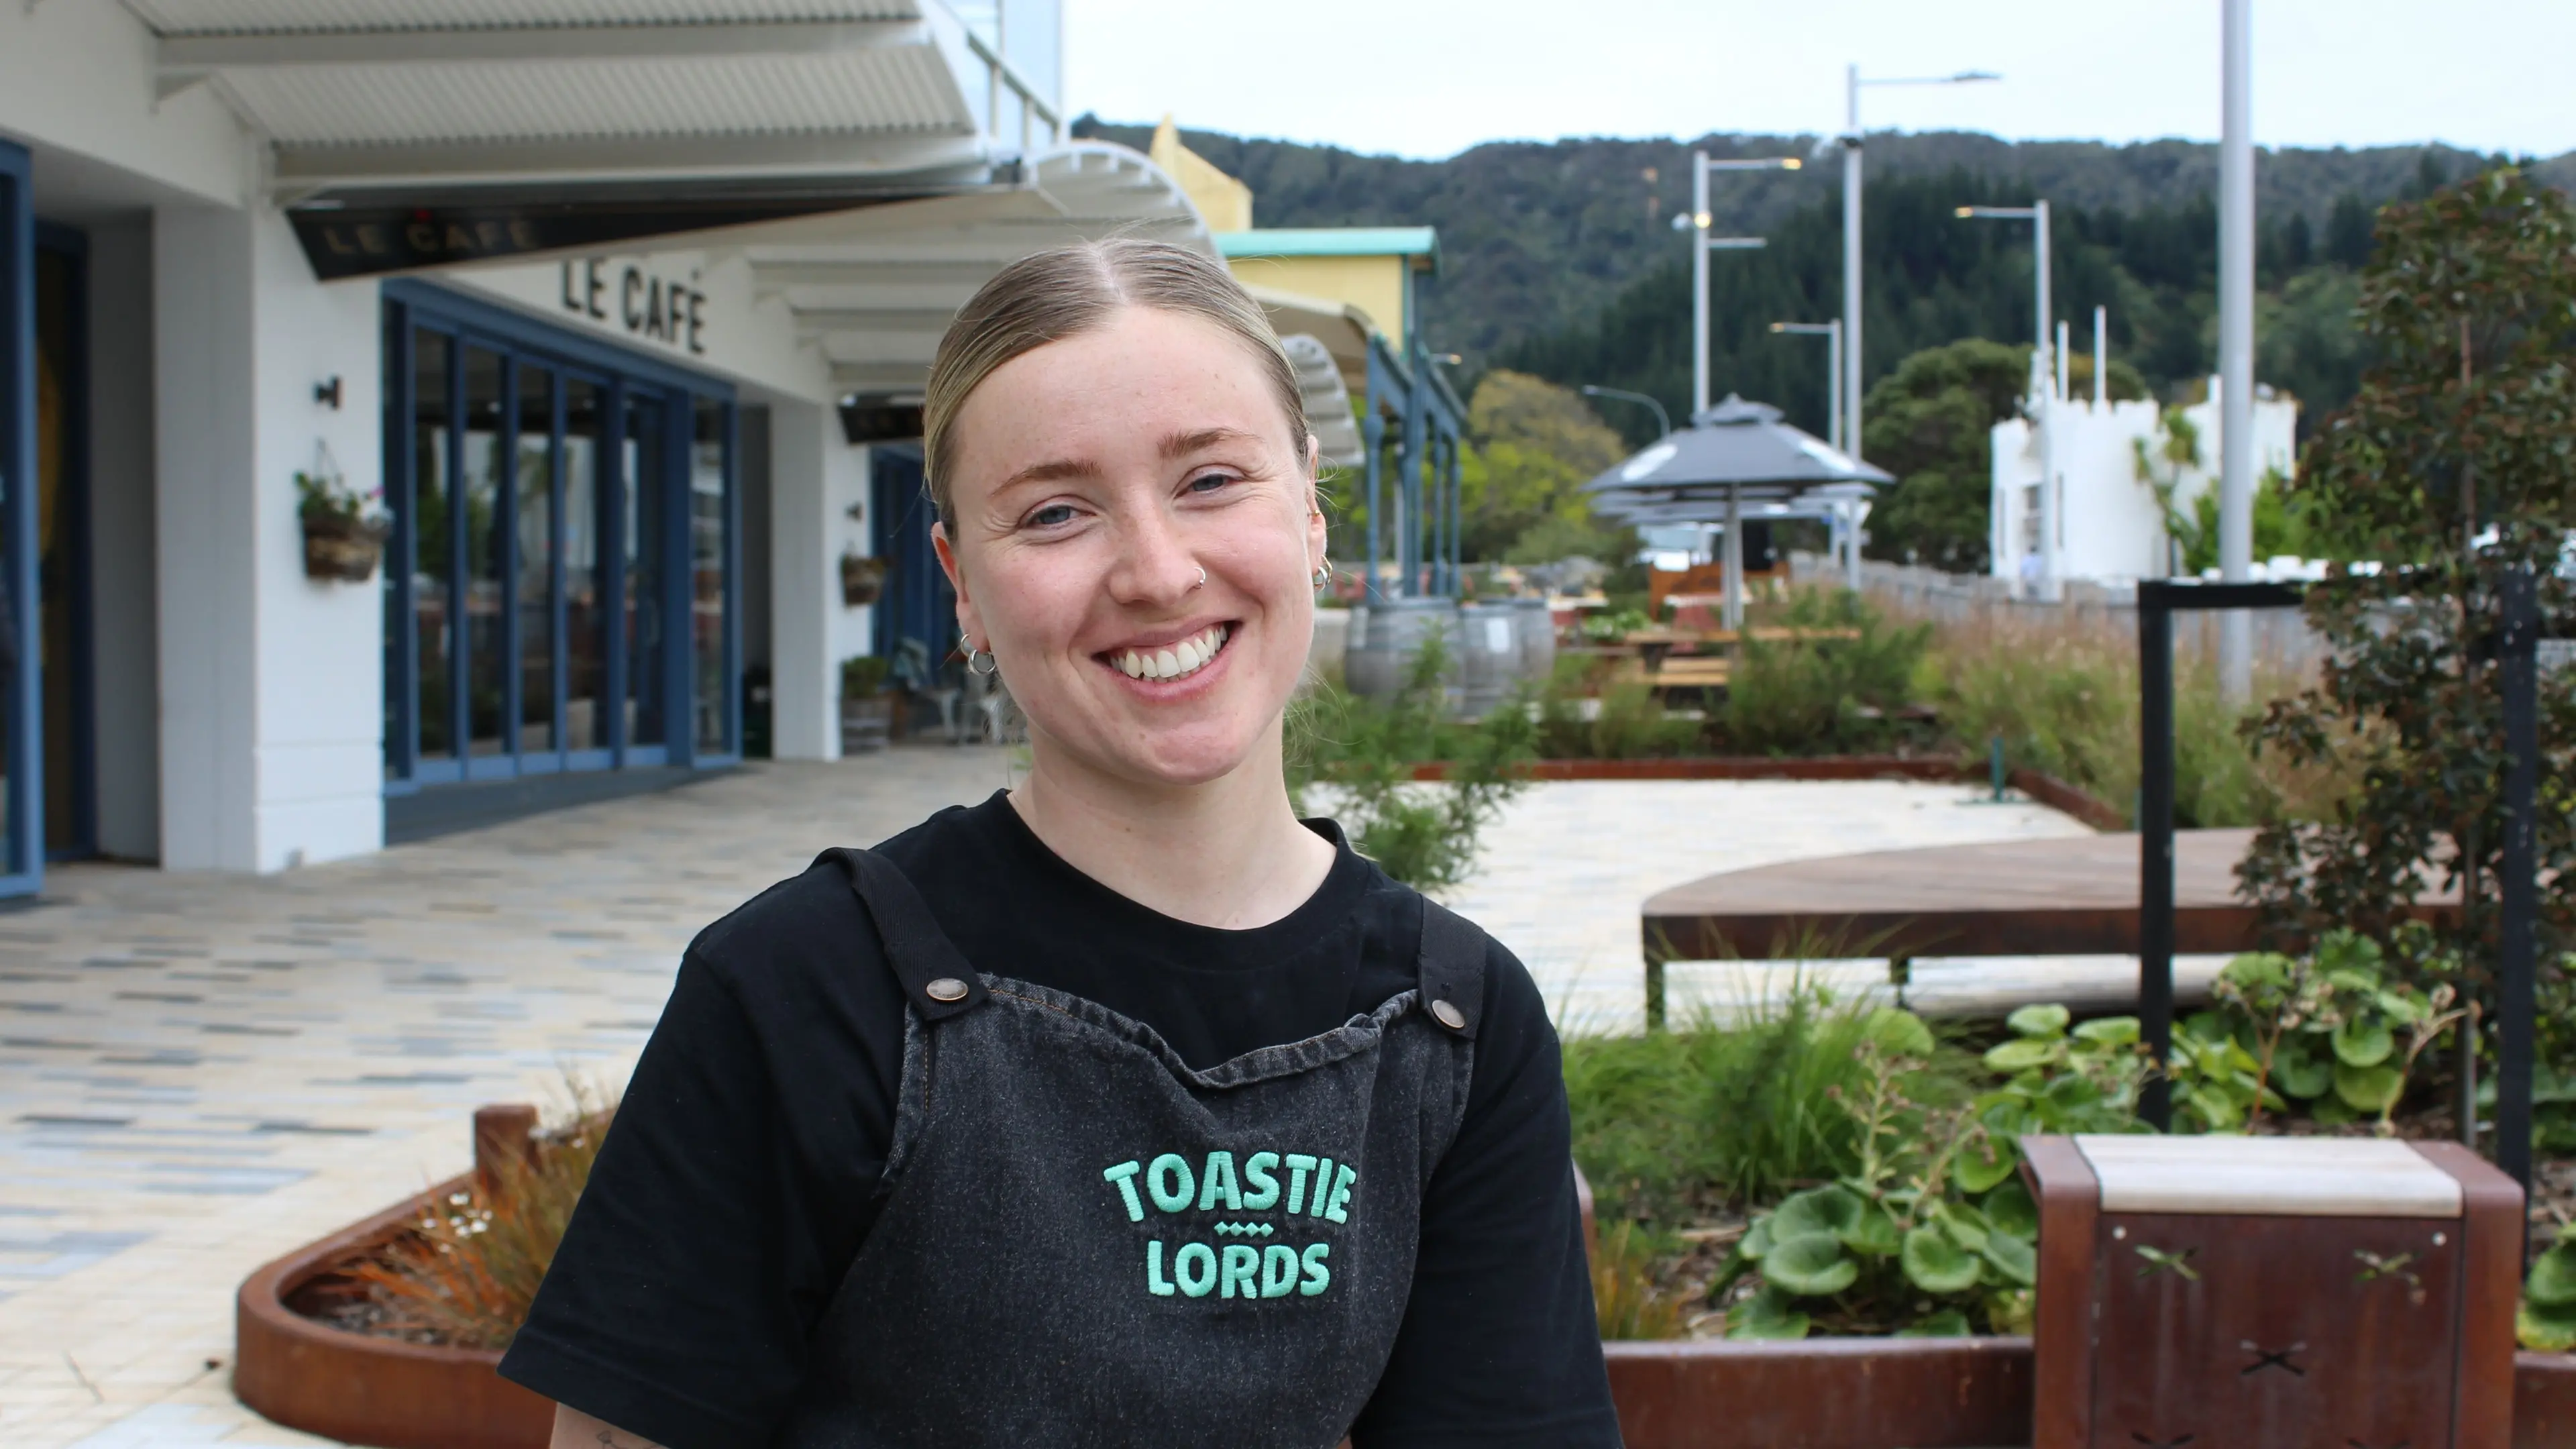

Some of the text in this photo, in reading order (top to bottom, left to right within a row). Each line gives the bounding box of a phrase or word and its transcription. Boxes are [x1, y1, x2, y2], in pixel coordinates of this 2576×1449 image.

[323, 223, 386, 254] LE
[562, 258, 606, 319] LE
[1104, 1151, 1356, 1224] TOASTIE
[1146, 1240, 1330, 1299] LORDS
